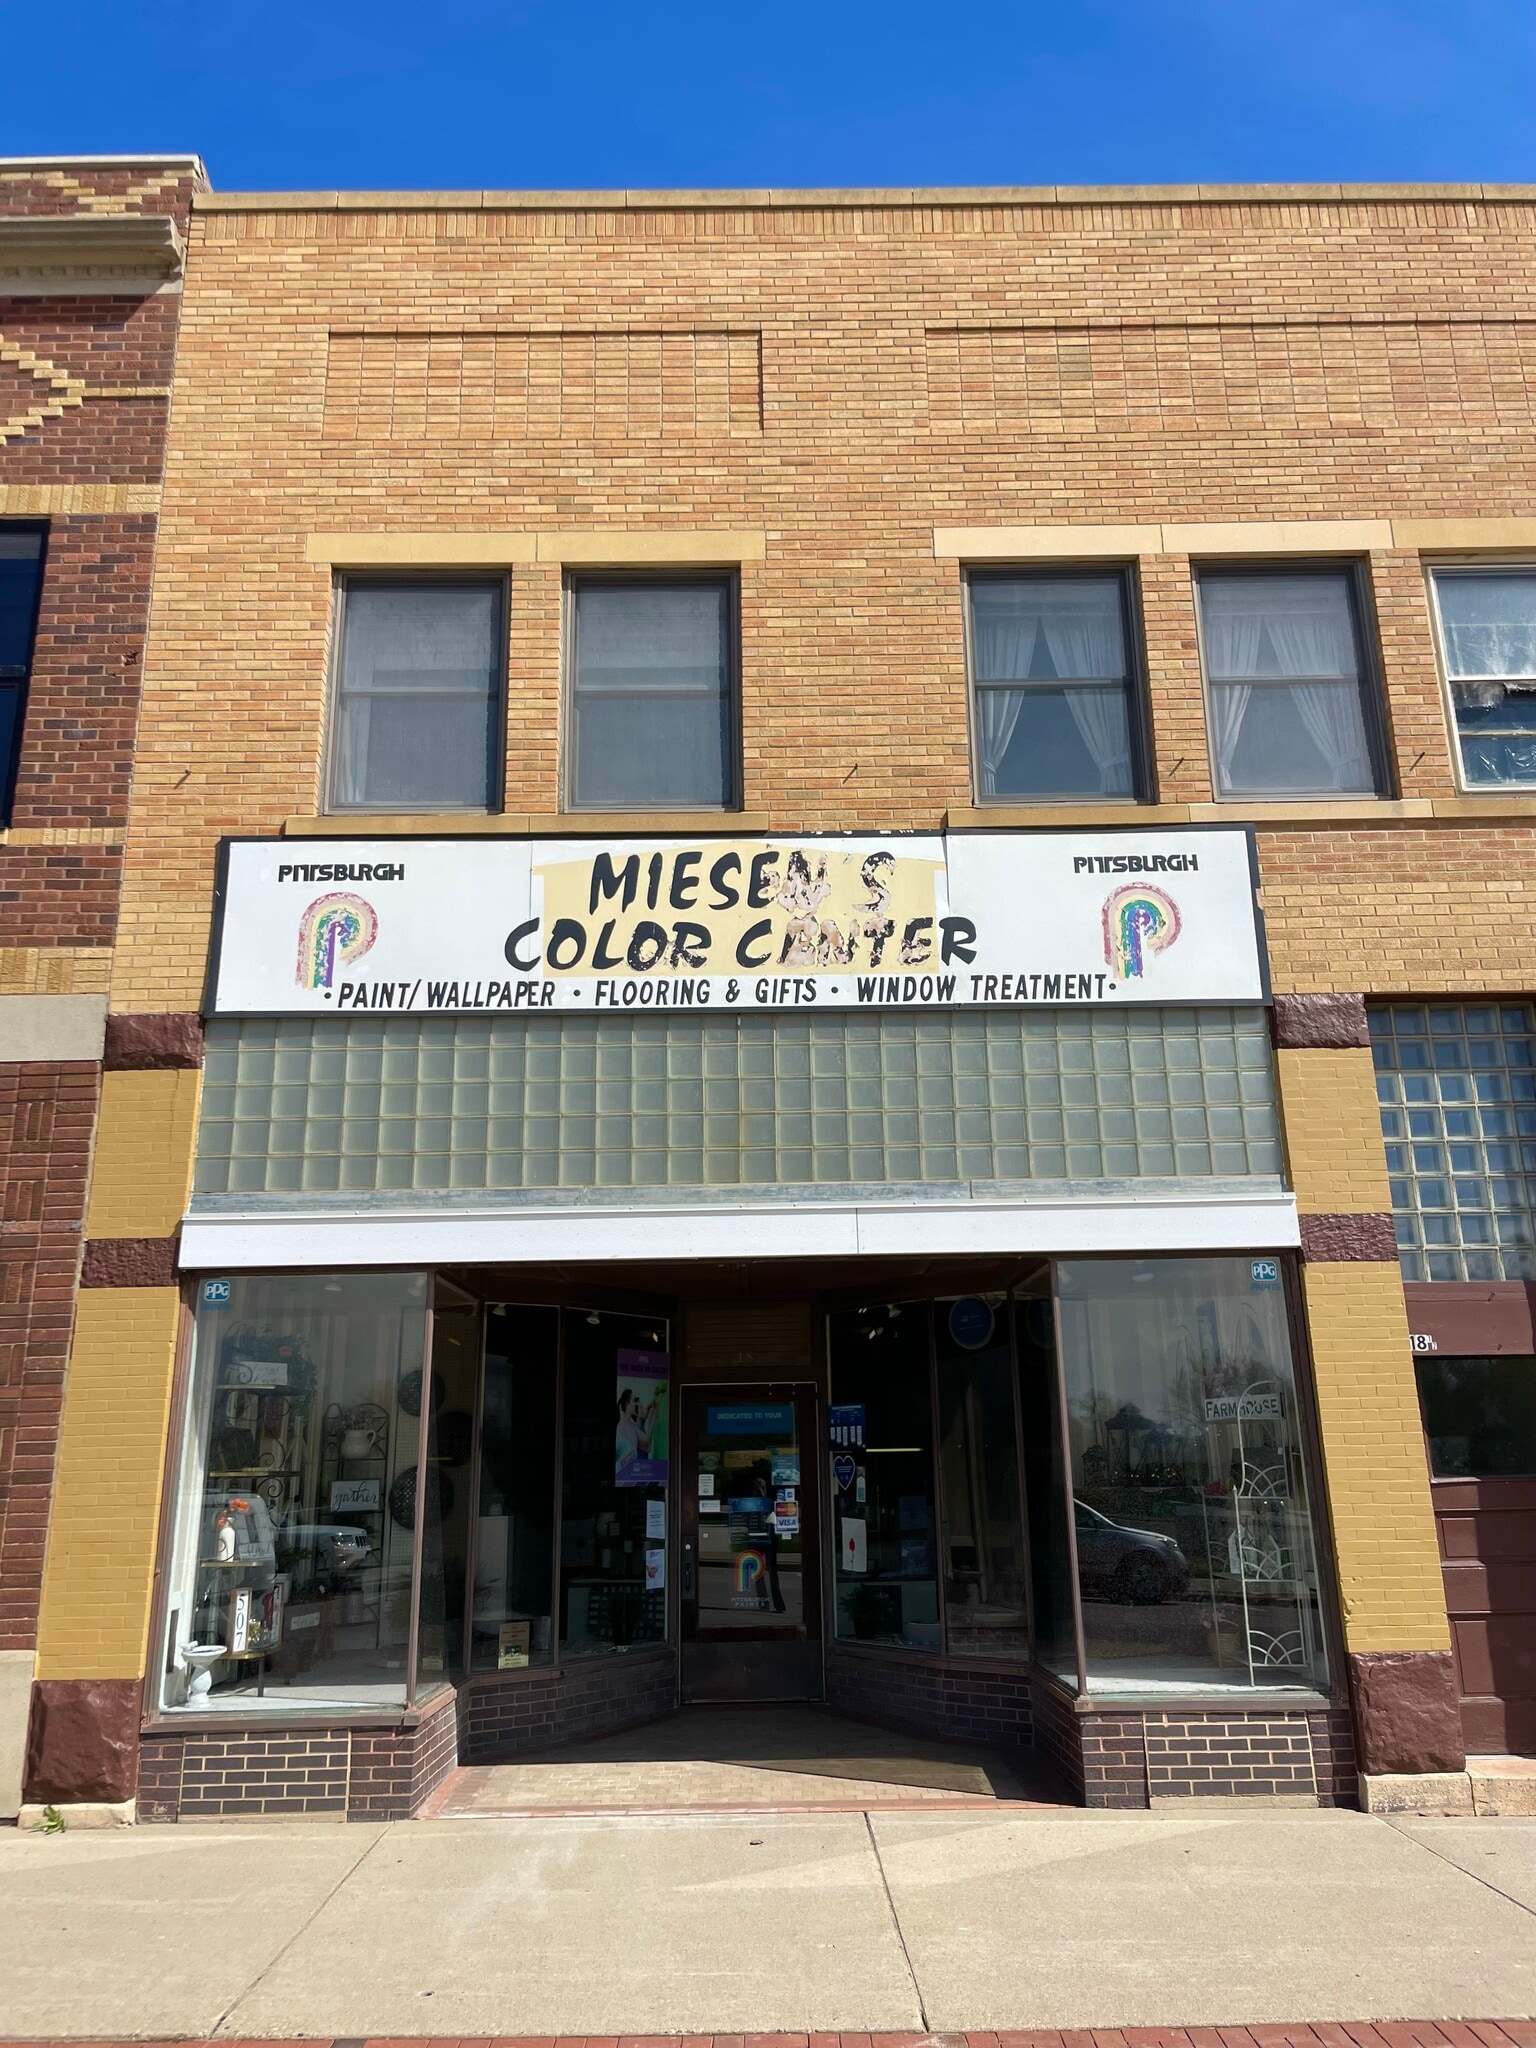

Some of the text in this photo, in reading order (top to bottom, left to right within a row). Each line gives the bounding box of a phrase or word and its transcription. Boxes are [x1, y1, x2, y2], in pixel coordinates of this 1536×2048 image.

[278, 863, 405, 882] PITTSBURGH
[1073, 853, 1198, 874] PITTSBURGH
[504, 915, 977, 972] COLOR CENTER
[594, 978, 711, 1008] FLOORING
[724, 980, 741, 1002] &
[755, 978, 817, 1004] GIFTS
[857, 975, 957, 1004] WINDOW
[970, 973, 1108, 1001] TREATMENT
[1253, 1263, 1276, 1279] PPG
[206, 1283, 229, 1299] PPG
[1409, 1335, 1427, 1350] 18
[717, 1412, 753, 1420] DEDICATED
[332, 1480, 378, 1511] gather
